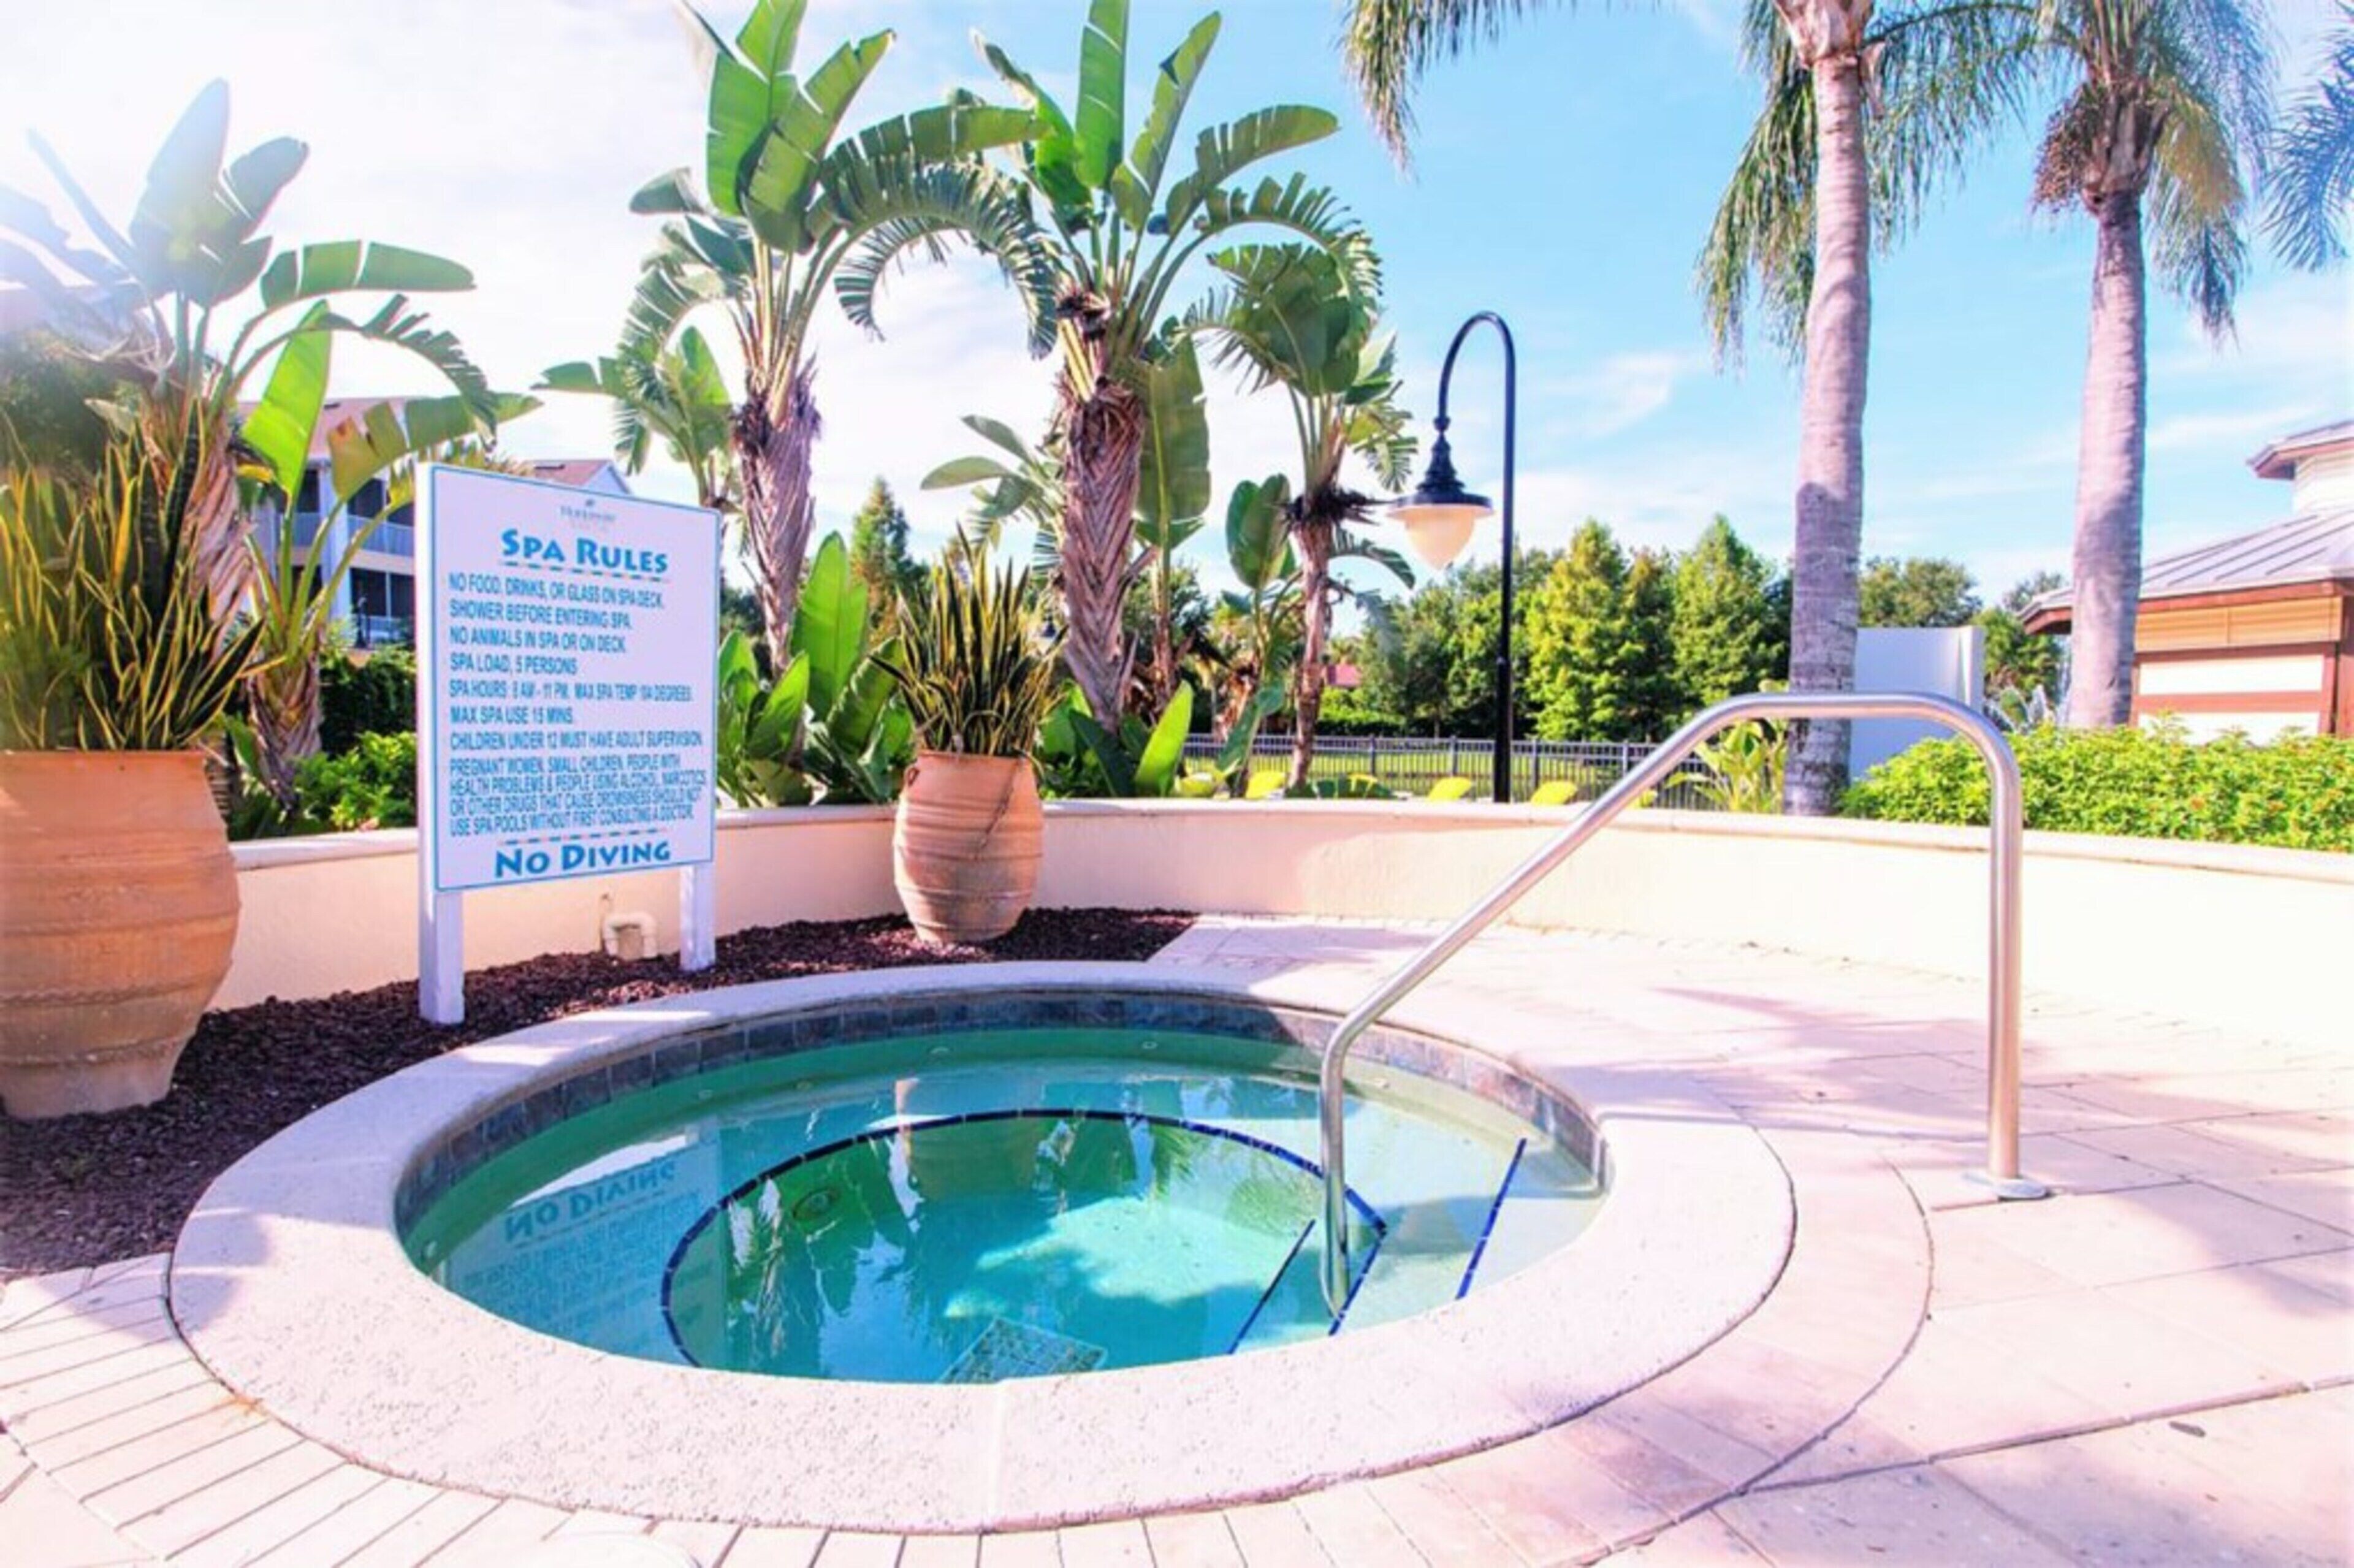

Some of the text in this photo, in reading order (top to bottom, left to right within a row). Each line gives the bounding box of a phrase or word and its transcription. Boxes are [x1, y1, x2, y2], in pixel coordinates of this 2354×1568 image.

[449, 573, 467, 592] NO
[550, 582, 565, 600] OR
[568, 584, 600, 603] GLASS
[602, 587, 616, 604] ON
[618, 588, 635, 606] SPA
[450, 598, 503, 621] SHOWER
[506, 603, 553, 624] BEFORE
[555, 606, 608, 627] ENTERING
[450, 625, 468, 645] NO
[471, 626, 522, 647] ANIMALS
[525, 630, 536, 648] IN
[539, 631, 559, 649] SPA
[561, 632, 577, 650] OR
[579, 633, 595, 651] ON
[450, 652, 474, 671] SPA
[516, 655, 522, 672] 5
[450, 679, 468, 698] SPA
[574, 682, 594, 700] MAX
[596, 682, 612, 701] SPA
[450, 706, 477, 724] MAX
[479, 706, 503, 724] SPA
[505, 706, 528, 724] USE
[451, 732, 506, 750] CHILDREN
[508, 731, 544, 749] UNDER
[546, 731, 557, 748] 12
[560, 731, 586, 748] MUST
[587, 731, 614, 748] HAVE
[615, 731, 644, 747] ADULT
[450, 757, 505, 775] PREGNANT
[548, 756, 578, 772] SMALL
[450, 777, 490, 796] HEALTH
[450, 819, 470, 837] USE
[473, 818, 493, 835] SPA
[494, 815, 527, 834] POOLS
[560, 840, 671, 870] DIVING
